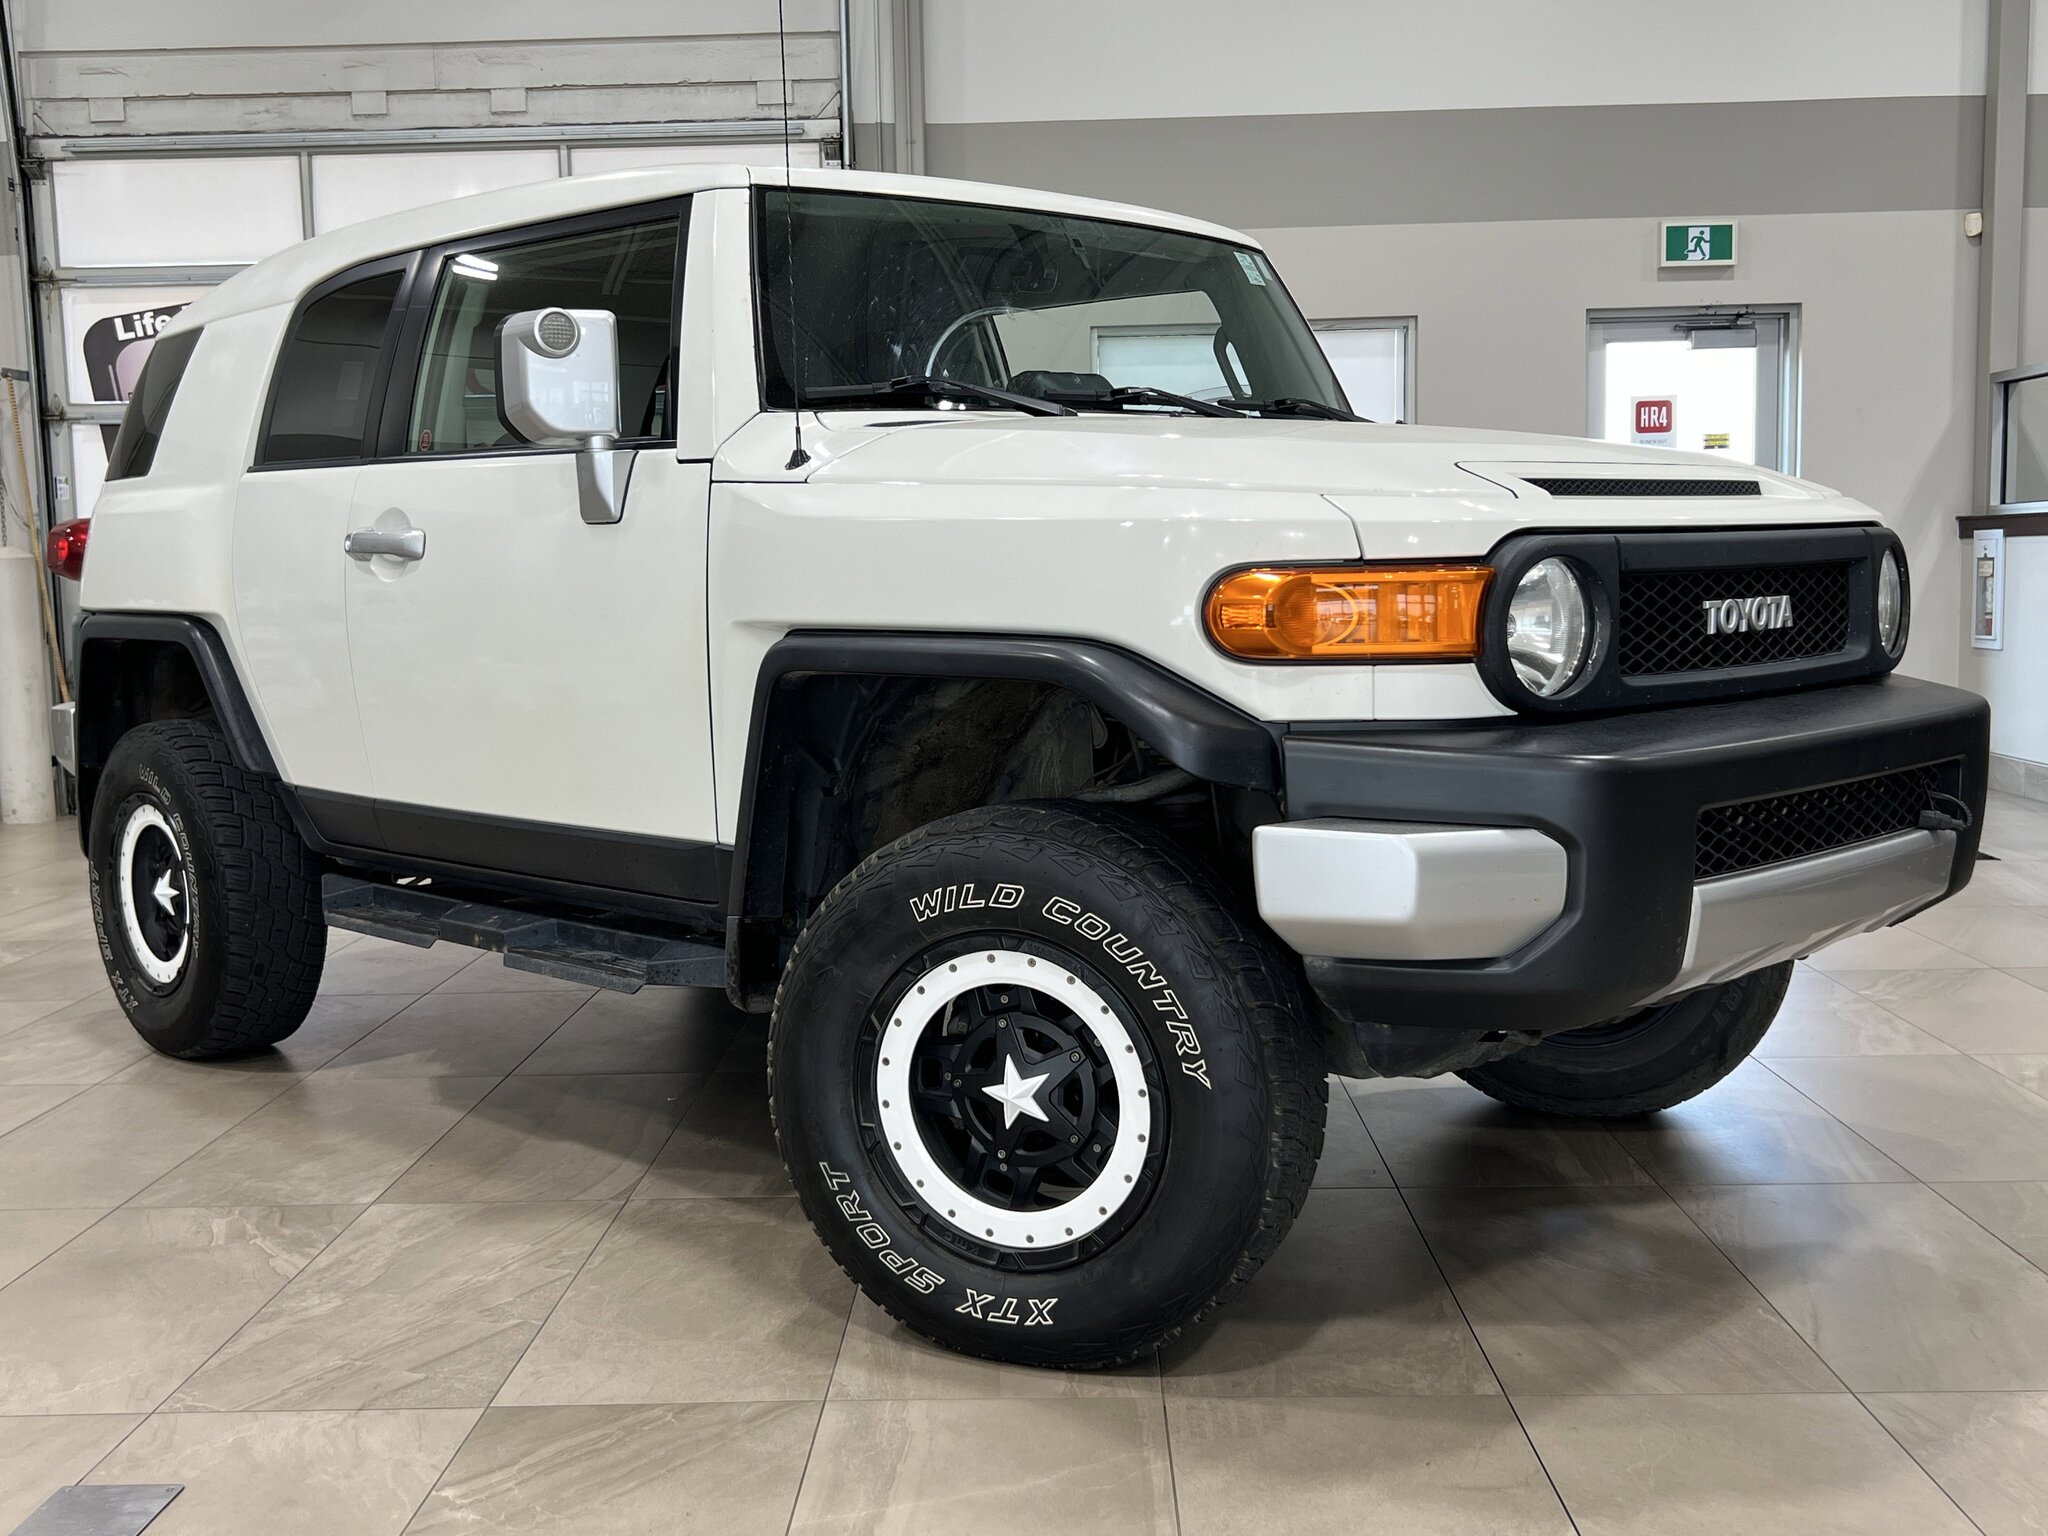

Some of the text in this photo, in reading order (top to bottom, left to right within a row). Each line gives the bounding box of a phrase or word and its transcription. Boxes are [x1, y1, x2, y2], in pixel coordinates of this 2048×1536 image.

[1640, 406, 1668, 428] HR4
[1703, 595, 1794, 635] TOYOTA
[139, 763, 173, 806] WILD
[909, 883, 1212, 1090] WILD COUNTRY
[819, 1161, 1059, 1326] XTX SPORT
